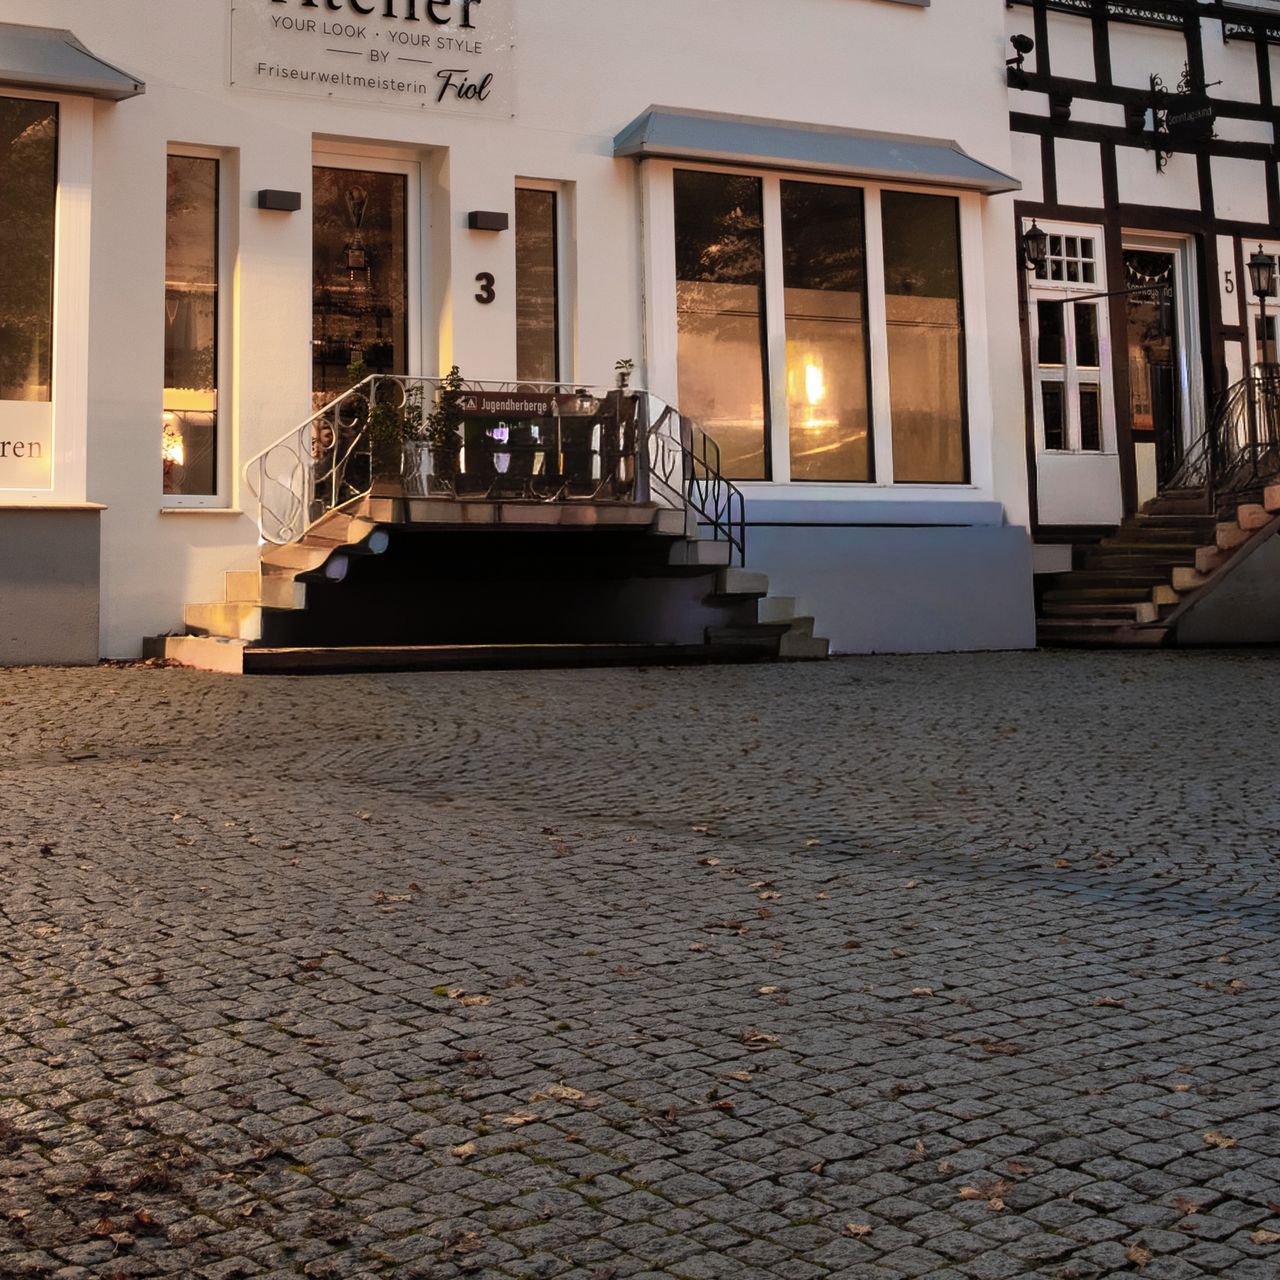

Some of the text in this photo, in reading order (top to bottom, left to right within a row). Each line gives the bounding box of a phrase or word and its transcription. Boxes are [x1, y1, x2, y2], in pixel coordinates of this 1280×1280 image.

[271, 15, 483, 54] YOUR LOOK YOUR STYLE
[370, 49, 390, 64] BY
[257, 62, 494, 103] Friseurweltmeisterin Fiol
[474, 272, 496, 304] 3
[1224, 270, 1234, 294] 5
[481, 398, 547, 414] Jugendherberge
